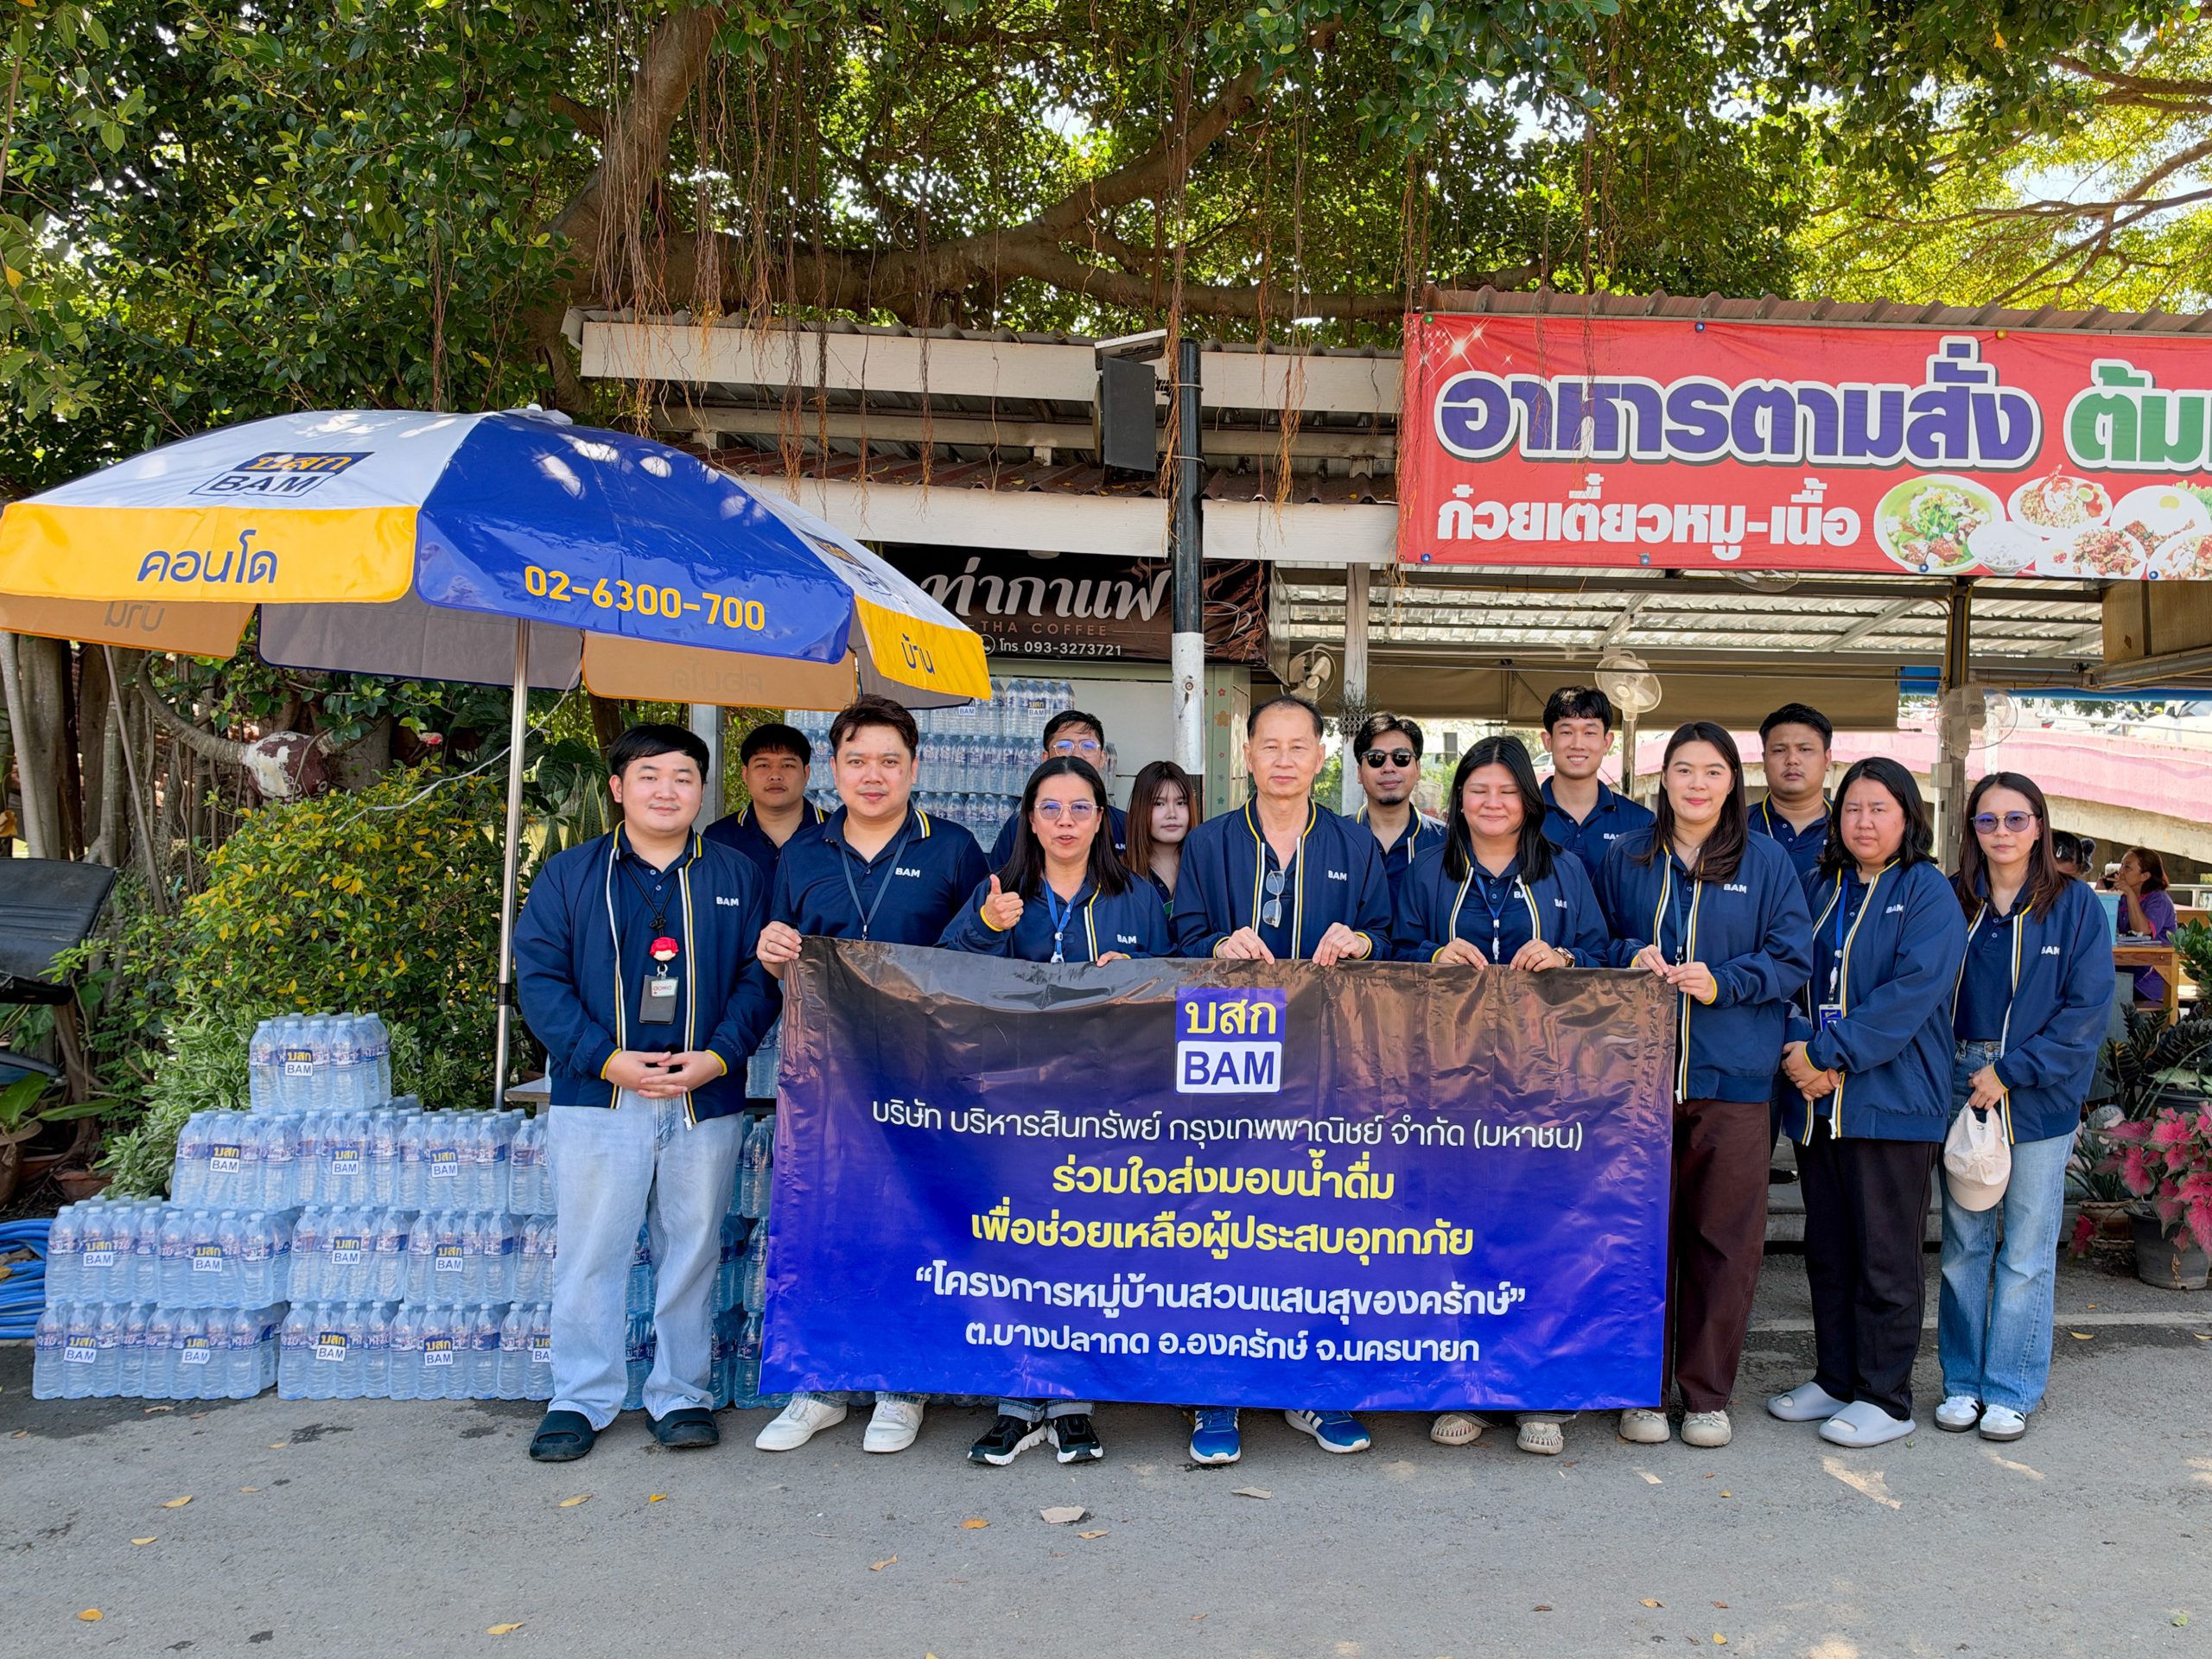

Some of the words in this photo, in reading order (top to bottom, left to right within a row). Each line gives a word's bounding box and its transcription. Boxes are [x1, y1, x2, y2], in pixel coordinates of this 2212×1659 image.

[1439, 340, 2037, 465] อาหารตามสั่ง
[2069, 364, 2212, 465] ต้ม
[248, 455, 352, 471] บสก
[207, 475, 320, 493] BAM
[1437, 473, 1860, 561] ก๋วยเตี๋ยวหมู-เนื้อ
[137, 529, 277, 584] คอนโด
[920, 556, 1172, 621] ท่ากาแฟ
[524, 565, 766, 631] 02-6300-700
[982, 620, 1018, 633] THA
[1032, 623, 1108, 636] COFFEE
[900, 633, 936, 675] บ้าน
[1024, 641, 1122, 657] 093-3273721
[895, 867, 920, 878] BAM
[1327, 870, 1348, 881] BAM
[1723, 884, 1747, 893] BAM
[716, 896, 740, 906] BAM
[1885, 904, 1904, 914] BAM
[1116, 933, 1137, 944] BAM
[1185, 1000, 1276, 1034] บสก
[287, 1052, 312, 1062] บสก
[287, 1065, 311, 1075] BAM
[1184, 1051, 1274, 1085] BAM
[872, 1098, 941, 1129] บริษัท
[950, 1107, 1162, 1141] บริหารสินทรัพย์
[1169, 1114, 1383, 1149] กรุงเทพพาณิชย์
[1390, 1115, 1465, 1147] จำกัด
[1473, 1122, 1582, 1152] (มหาชน)
[213, 1146, 239, 1158] บสก
[334, 1150, 357, 1160] บสก
[432, 1152, 455, 1162] บสก
[212, 1160, 238, 1172] BAM
[334, 1163, 357, 1173] BAM
[434, 1165, 456, 1175] BAM
[1052, 1148, 1395, 1200] ร่วมใจส่งมอบน้ำดื่ม
[971, 1196, 1473, 1266] เพื่อช่วยเหลือผู้ประสบอุทกภัย
[85, 1241, 111, 1252] บสก
[334, 1239, 359, 1249] บสก
[196, 1246, 221, 1256] บสก
[437, 1247, 462, 1257] บสก
[86, 1255, 111, 1265] BAM
[334, 1253, 359, 1262] BAM
[195, 1260, 220, 1270] BAM
[437, 1259, 461, 1270] BAM
[915, 1259, 1526, 1325] “โครงการหมู่บ้านสวนแสนสุของครักษ์”
[69, 1337, 97, 1348] บสก
[321, 1335, 346, 1346] บสก
[425, 1340, 451, 1351] บสก
[536, 1338, 551, 1348] บส
[965, 1321, 1149, 1355] ต.บางปลากด
[1158, 1328, 1308, 1361] อ.องครักษ์
[1316, 1338, 1479, 1363] จ.นครนายก
[67, 1350, 94, 1361] BAM
[184, 1351, 207, 1362] BAM
[319, 1347, 343, 1359] BAM
[426, 1353, 451, 1364] BAM
[534, 1351, 550, 1361] BA
